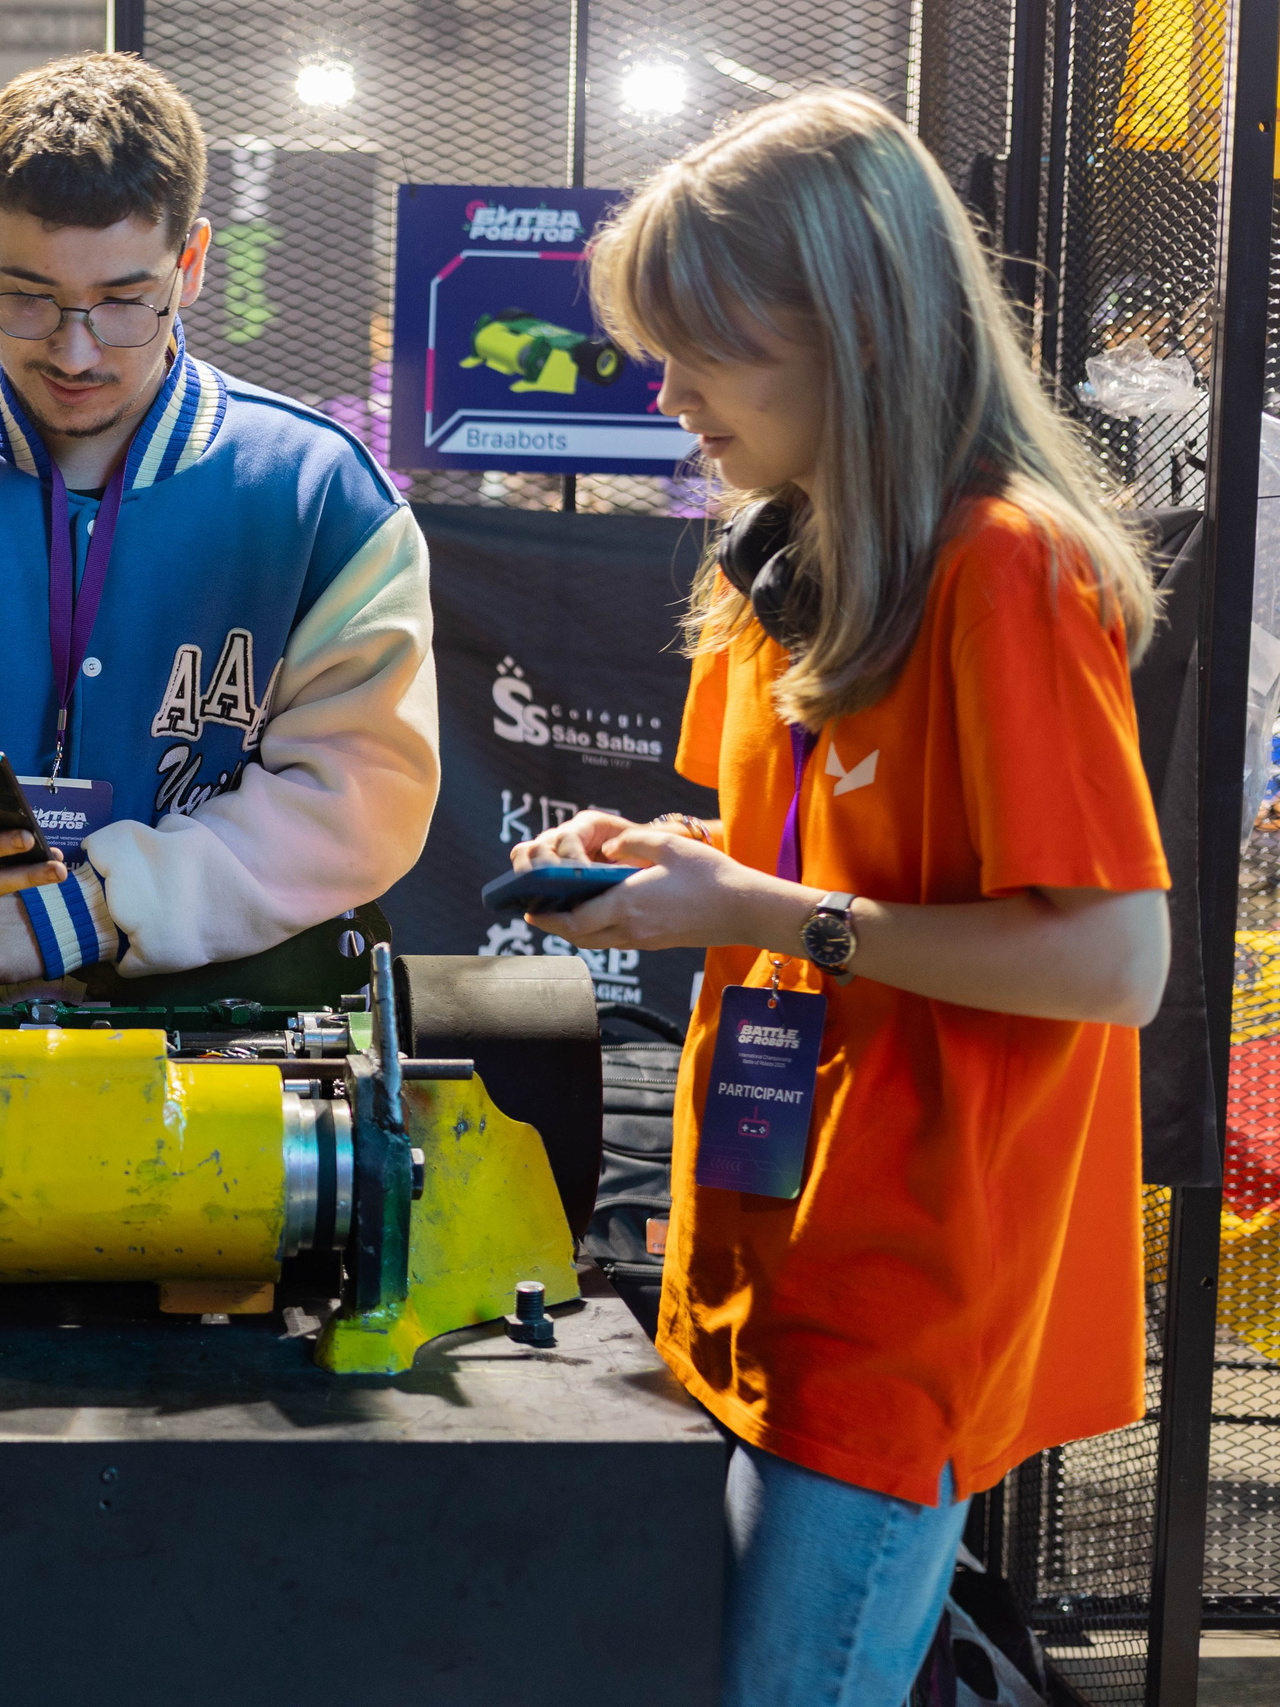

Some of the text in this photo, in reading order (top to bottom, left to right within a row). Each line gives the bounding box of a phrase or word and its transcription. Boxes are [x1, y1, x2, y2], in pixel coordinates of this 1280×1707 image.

[466, 428, 567, 450] Braabots
[551, 724, 663, 756] São Sabas
[595, 983, 643, 1005] GEM
[738, 1035, 800, 1049] OF ROBOTS
[740, 1025, 799, 1040] BATTLE
[718, 1082, 803, 1104] PARTICIPANT
